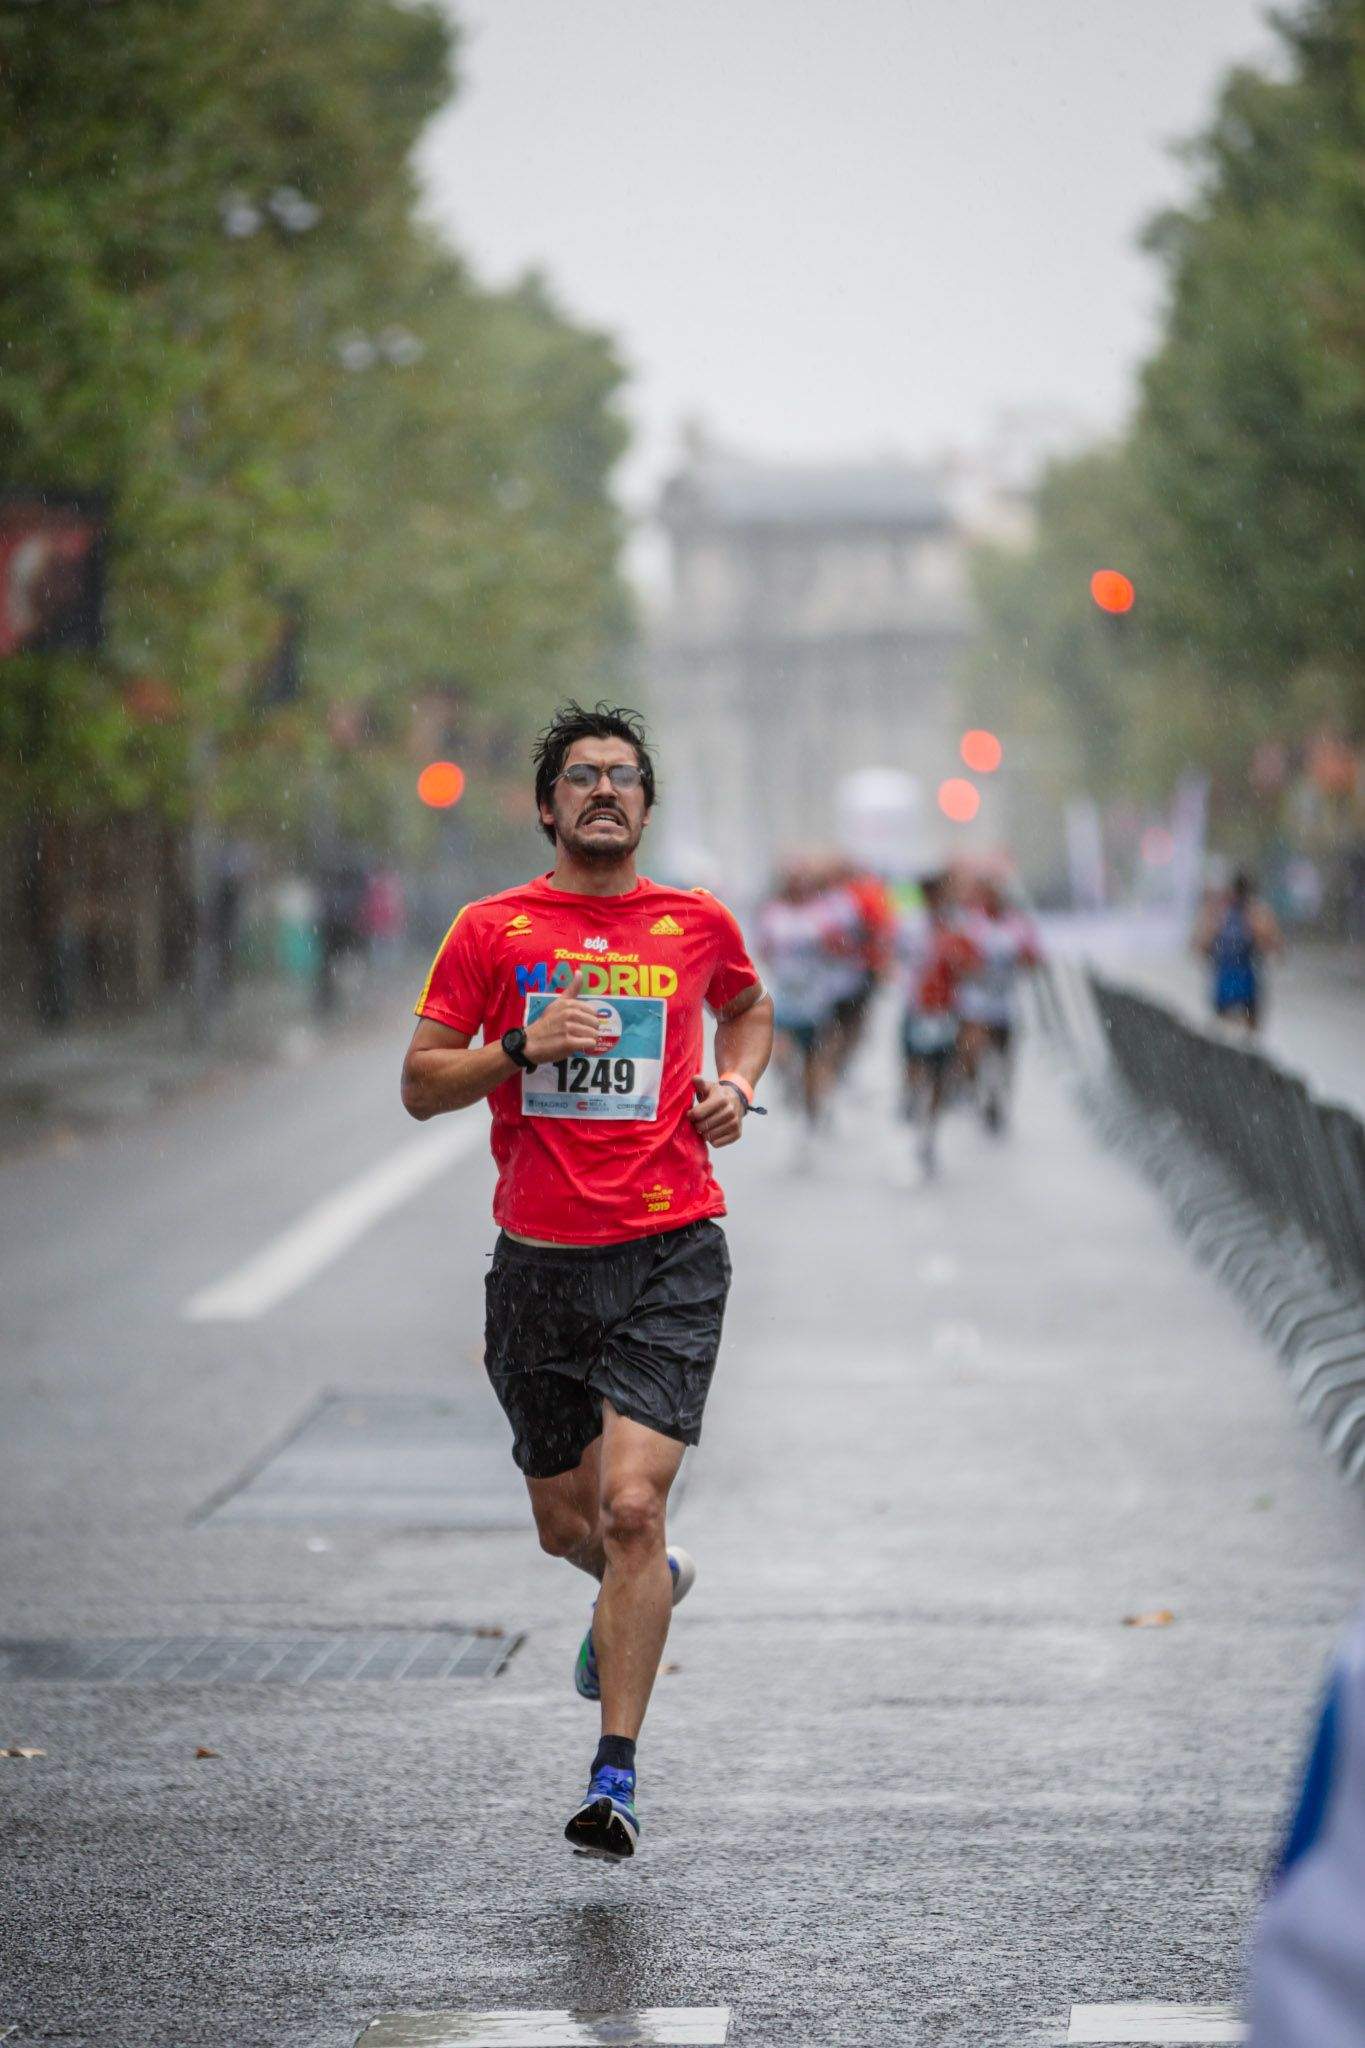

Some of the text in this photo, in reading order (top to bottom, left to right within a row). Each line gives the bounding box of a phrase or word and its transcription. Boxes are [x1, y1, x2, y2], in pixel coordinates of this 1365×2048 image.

[650, 927, 684, 936] adidas
[584, 937, 608, 952] edp
[555, 949, 594, 961] Rock
[607, 953, 639, 962] Roll
[515, 961, 678, 997] MADRID
[553, 1058, 635, 1094] 1249
[648, 1201, 670, 1212] 2019
